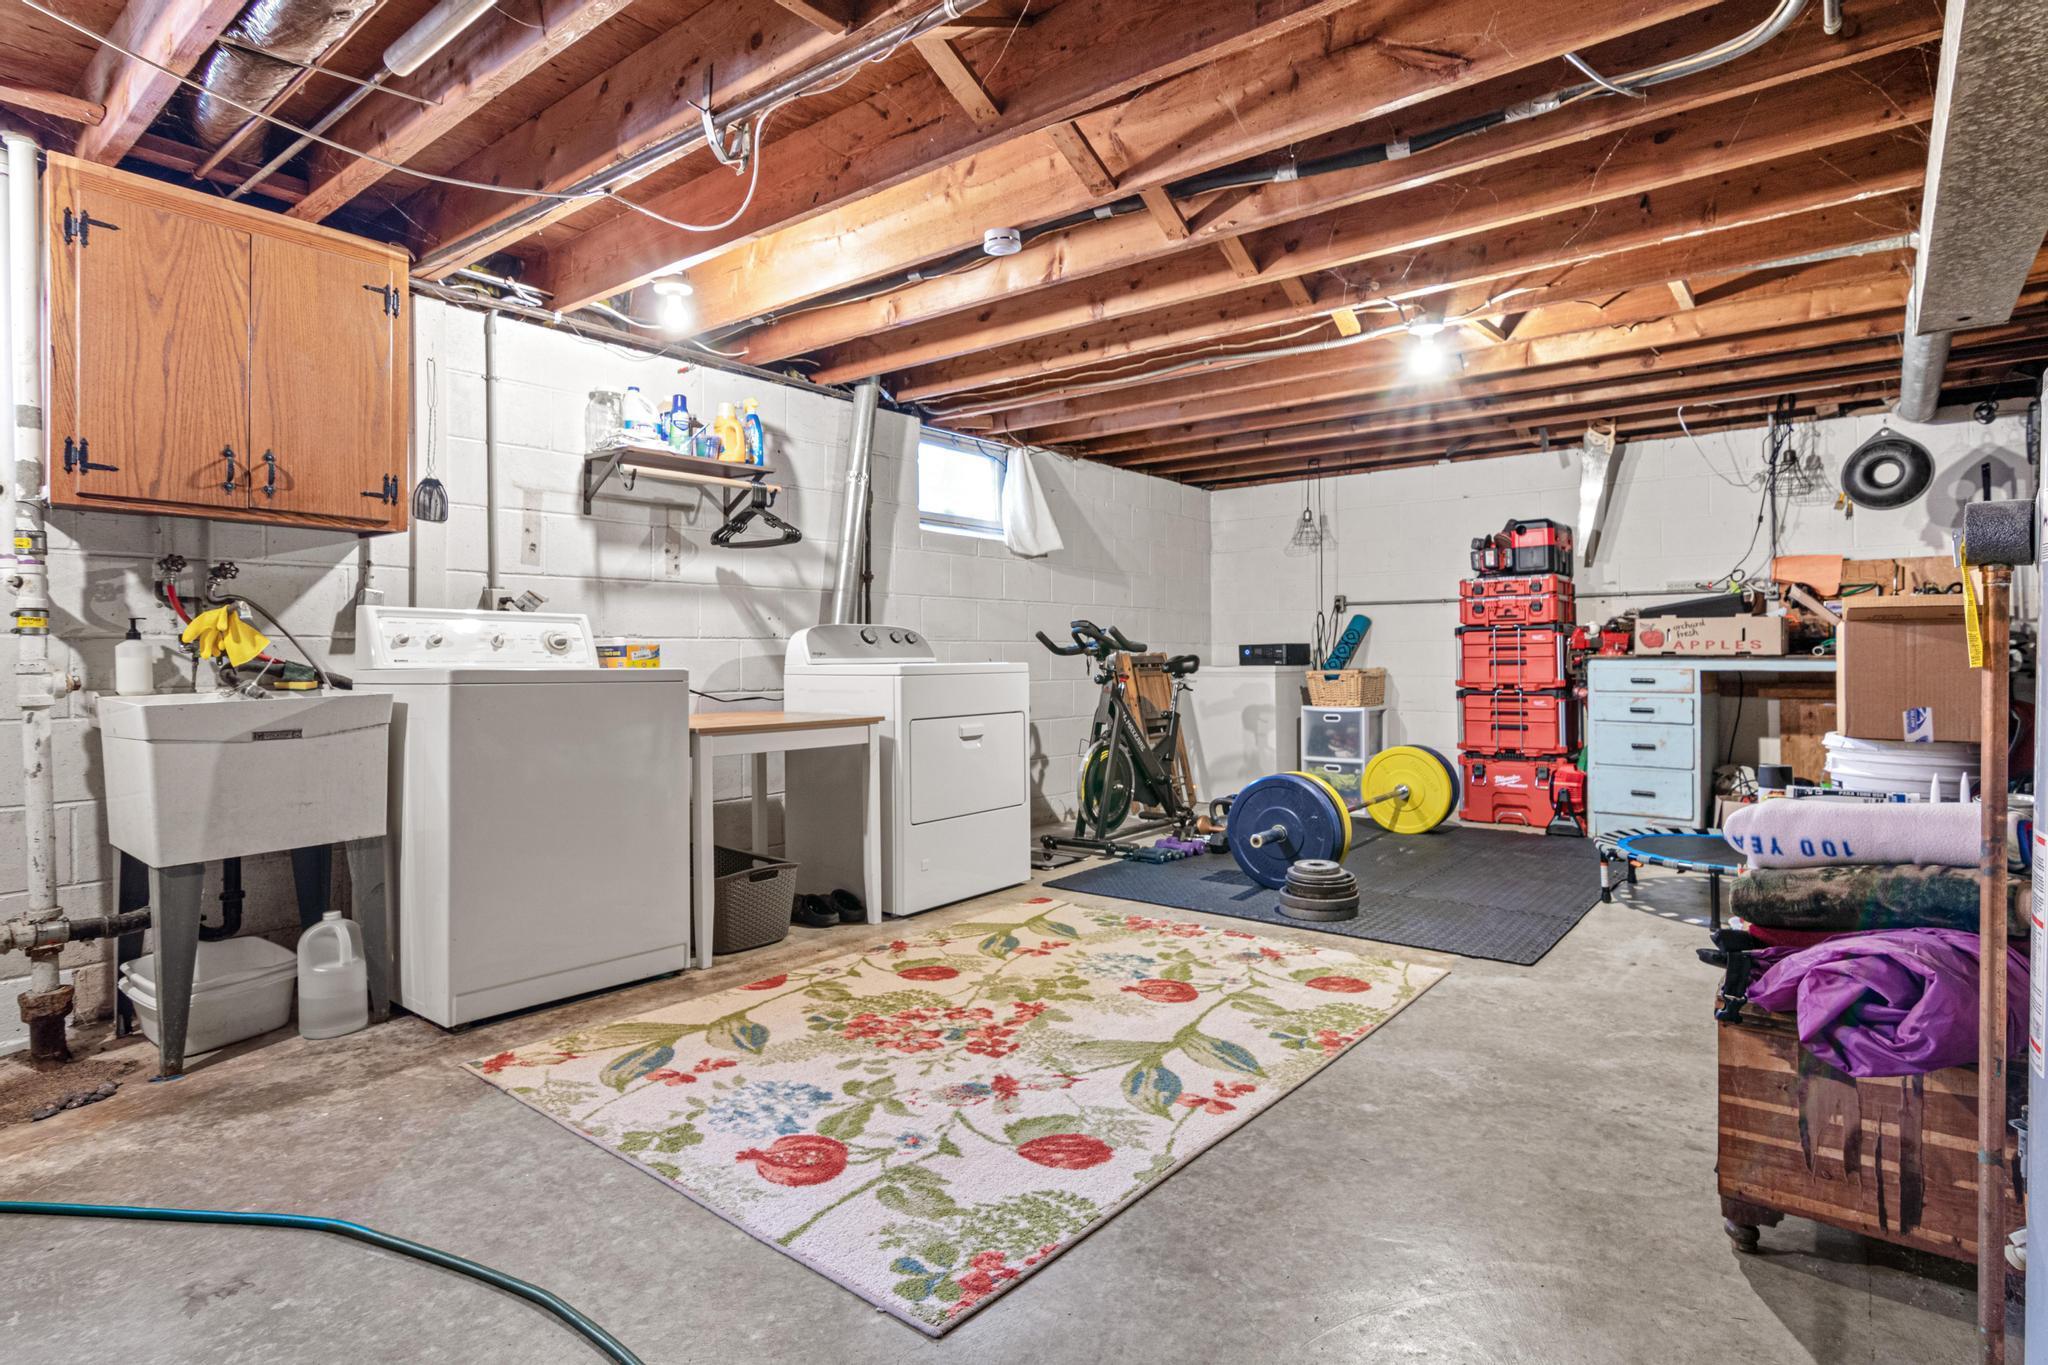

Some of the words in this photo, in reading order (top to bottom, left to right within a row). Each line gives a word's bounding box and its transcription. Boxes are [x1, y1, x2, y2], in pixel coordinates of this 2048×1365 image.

[1673, 618, 1706, 631] orchard
[1676, 628, 1699, 639] fresh
[1673, 639, 1762, 650] APPLES
[1800, 838, 1854, 857] 100
